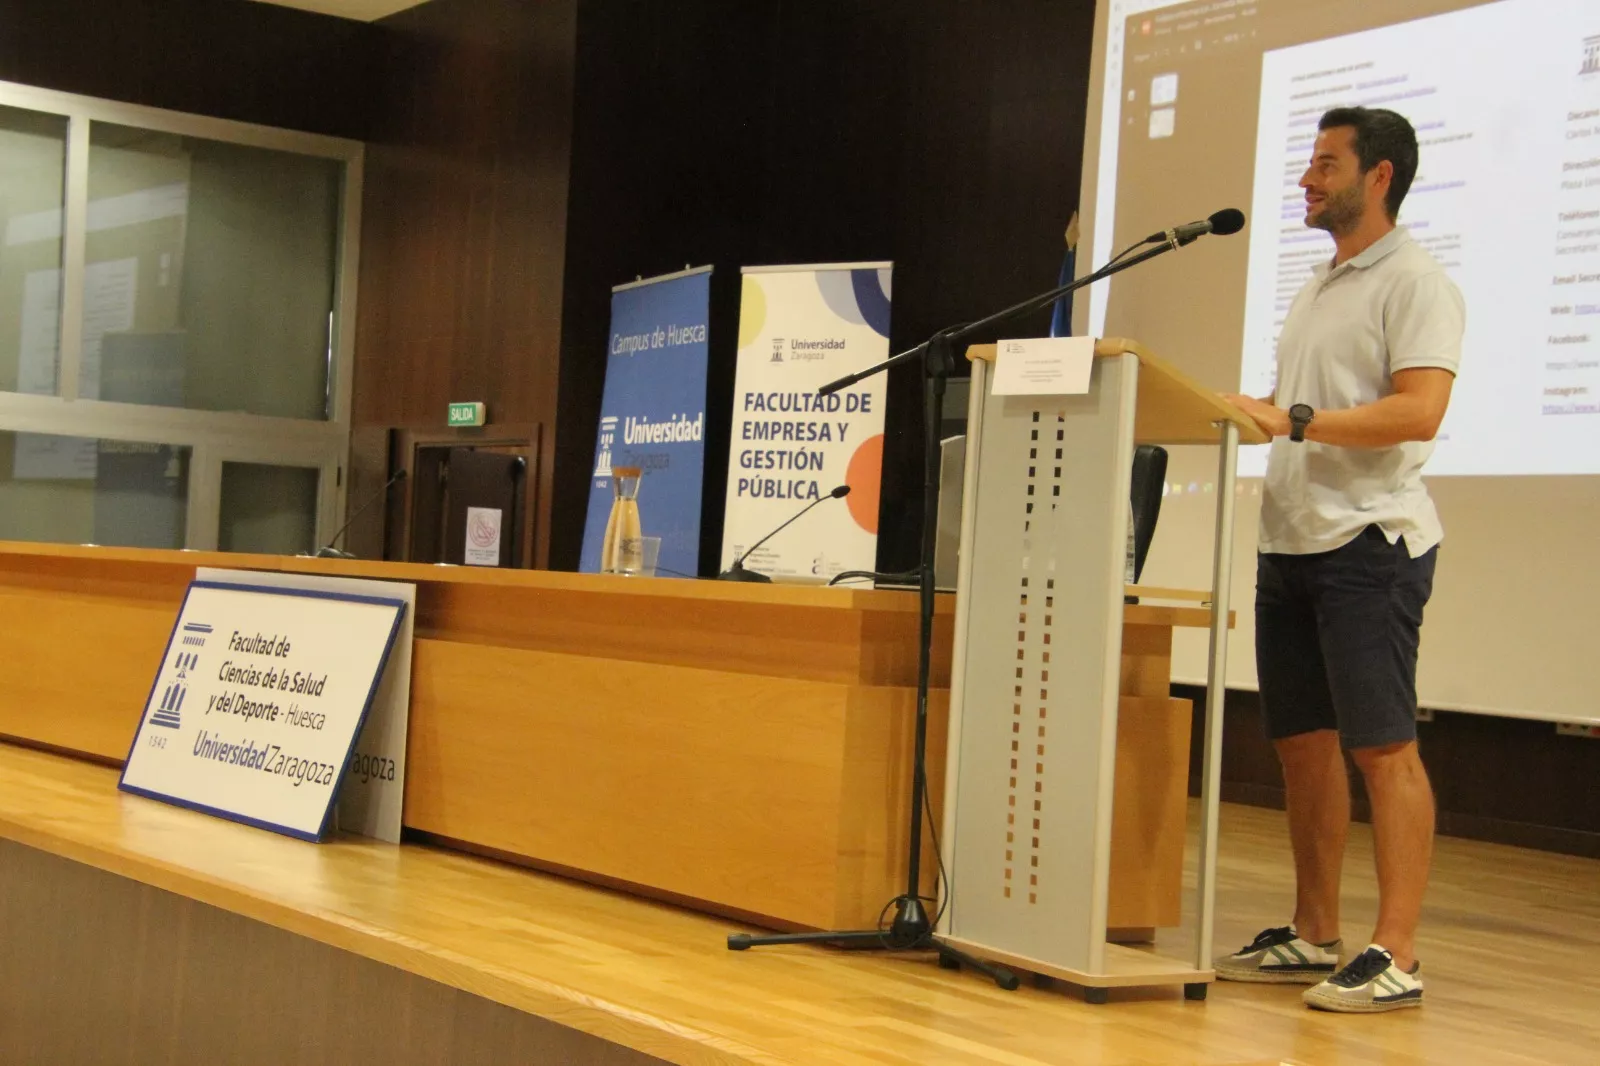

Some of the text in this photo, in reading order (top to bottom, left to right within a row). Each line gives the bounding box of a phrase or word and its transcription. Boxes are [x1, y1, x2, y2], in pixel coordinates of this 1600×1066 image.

[611, 323, 706, 356] Campus de Huesca
[791, 338, 846, 350] Universidad
[790, 351, 825, 362] Zaragoza
[451, 407, 474, 421] SALIDA
[744, 392, 872, 413] FACULTAD DE
[624, 412, 703, 445] Universidad
[742, 420, 849, 442] EMPRESA Y
[739, 446, 824, 471] GESTIÓN
[737, 475, 820, 500] PÚBLICA
[228, 630, 291, 657] Facultad de
[218, 661, 328, 697] Ciencias de la Salud
[205, 694, 215, 715] y
[216, 692, 234, 714] del
[233, 695, 279, 722] Deporte
[285, 703, 326, 731] Huesca
[148, 736, 167, 749] 1542
[352, 752, 395, 784] agoza
